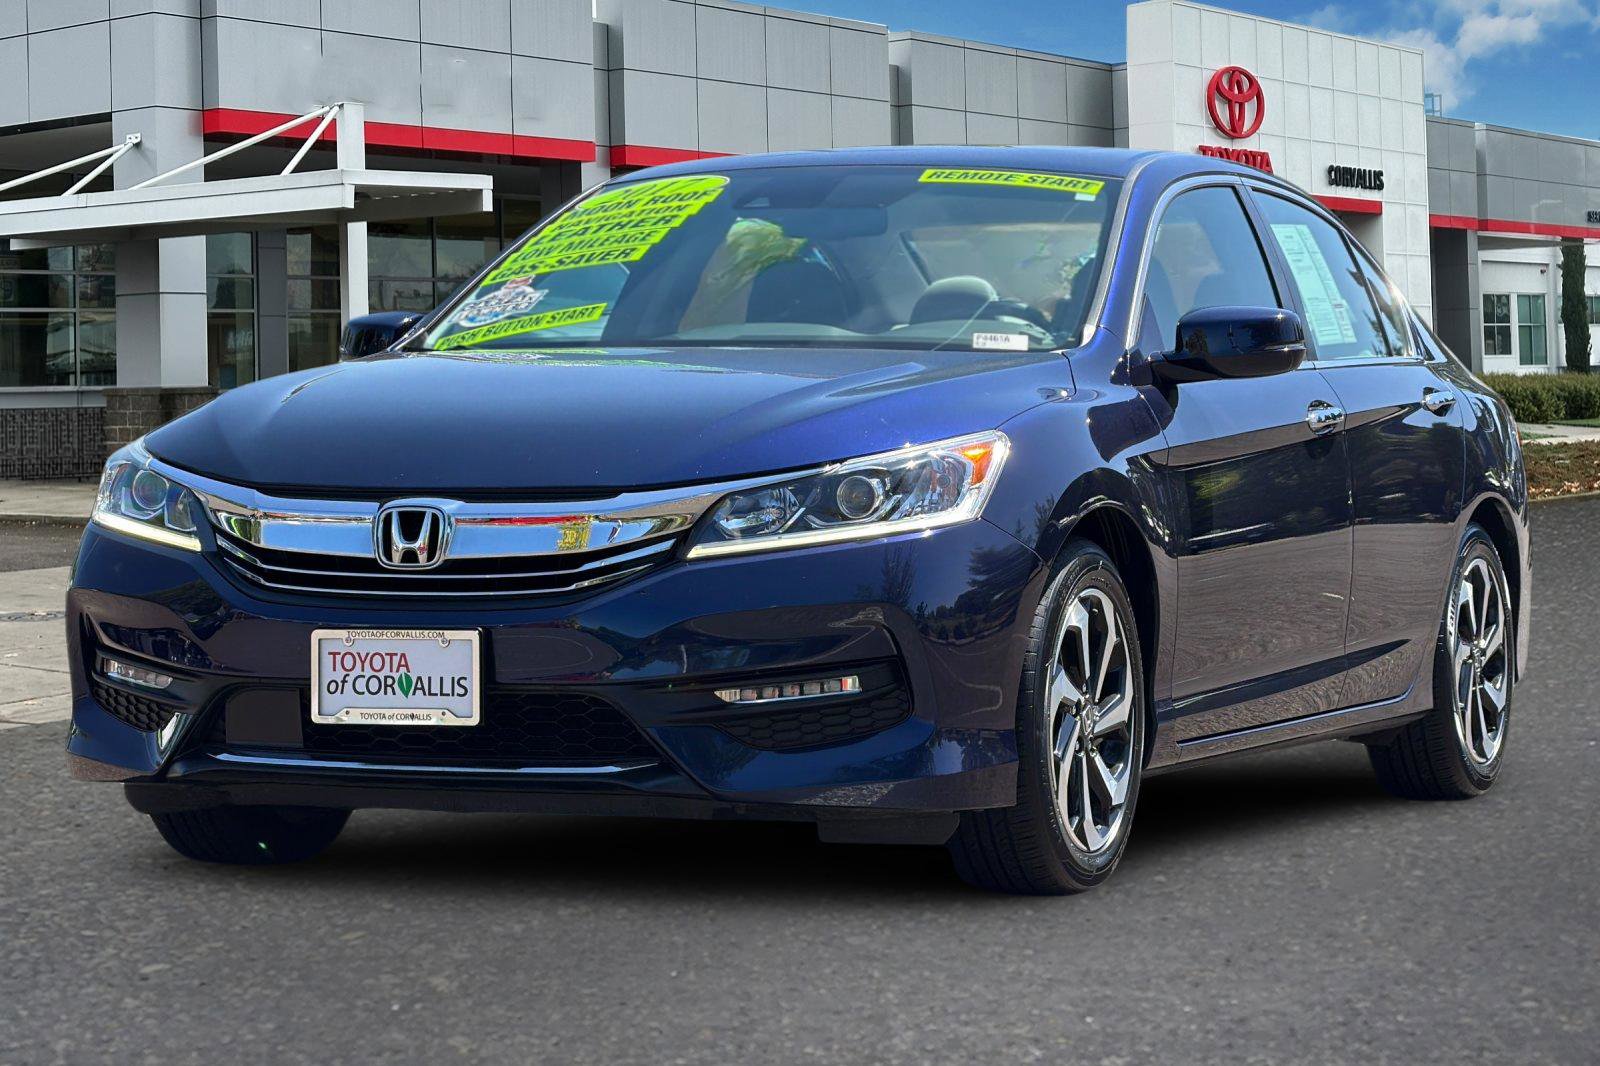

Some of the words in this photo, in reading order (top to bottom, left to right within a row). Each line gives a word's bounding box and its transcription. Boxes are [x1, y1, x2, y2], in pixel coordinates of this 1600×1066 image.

[926, 170, 1019, 183] REMOTE
[1023, 175, 1098, 191] START
[1327, 164, 1385, 191] CORVALLIS
[566, 199, 641, 220] MOON
[643, 188, 718, 206] ROOF
[531, 215, 679, 247] LEATHER
[552, 204, 691, 232] NAVIGATION
[510, 244, 558, 264] LOW
[558, 230, 660, 257] MILEAGE
[440, 331, 483, 347] PUSH
[481, 316, 545, 338] BUTTON
[546, 305, 601, 324] START
[347, 630, 446, 639] TOYOTAOFCORVALLIS.COM
[328, 651, 411, 673] TOYOTA
[326, 673, 350, 695] of
[360, 712, 387, 720] TOYOTA
